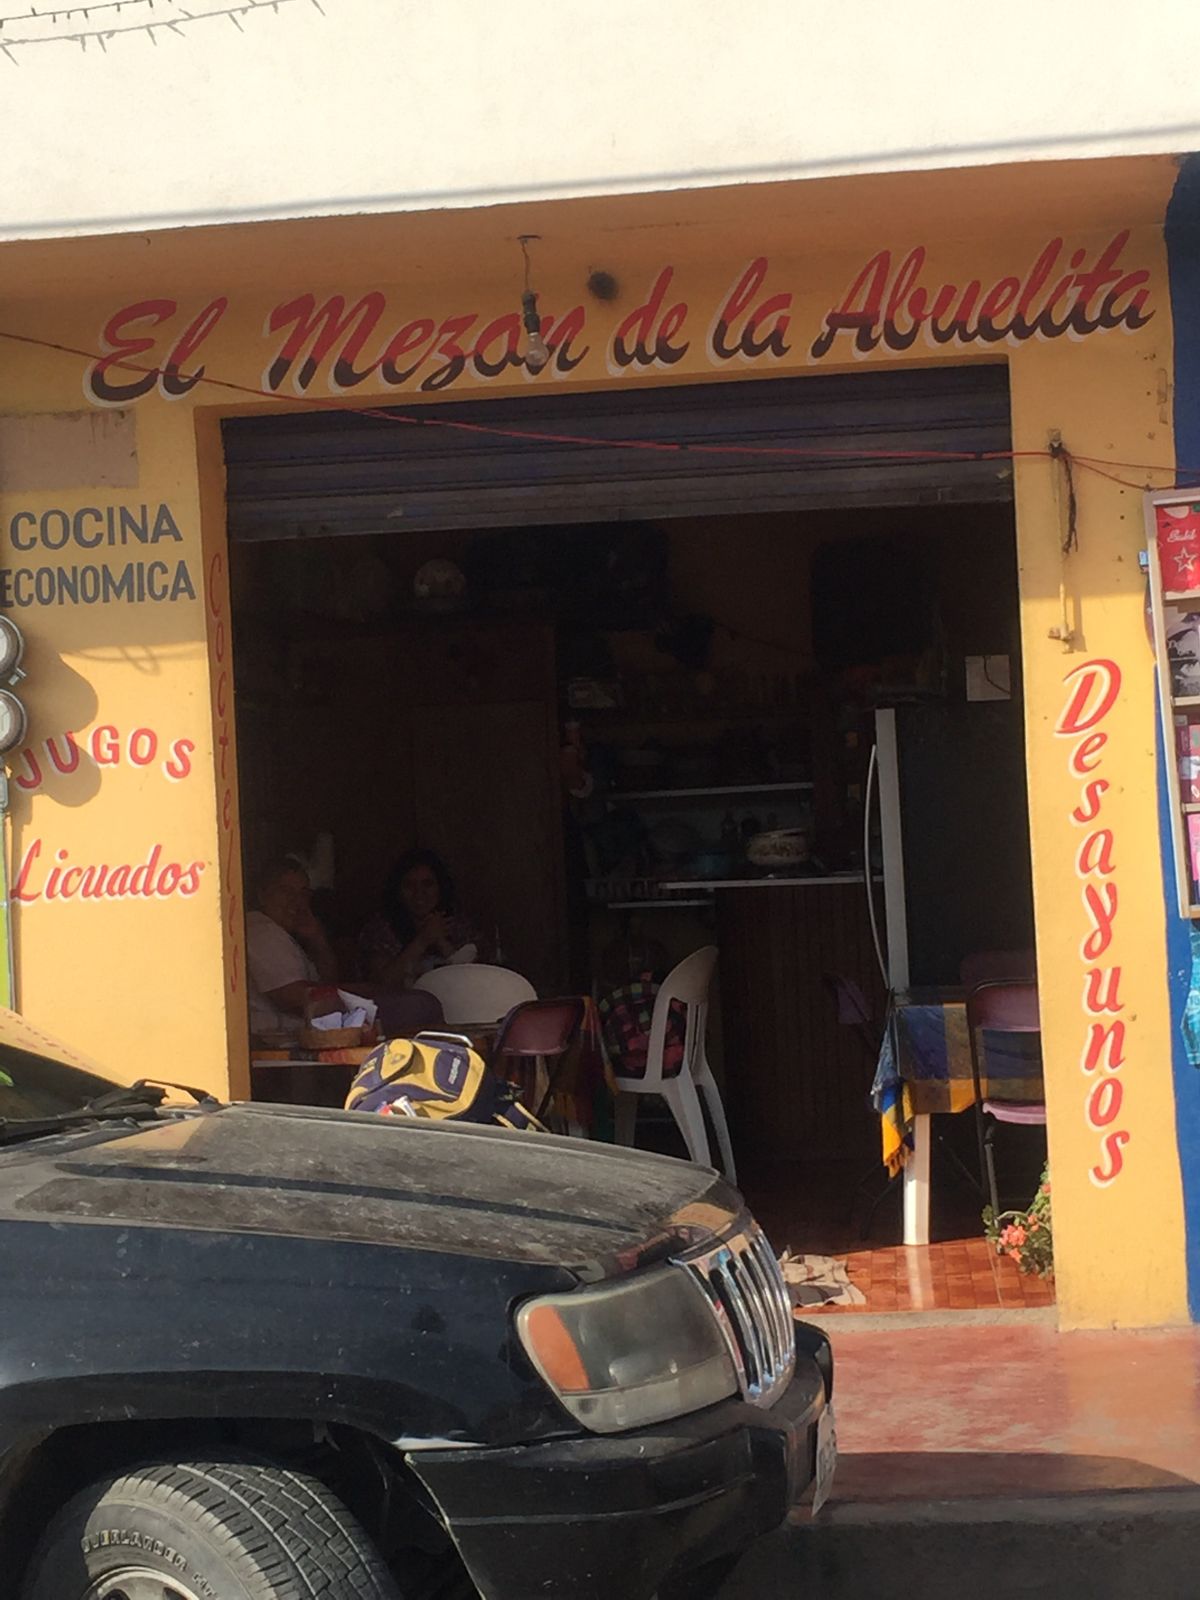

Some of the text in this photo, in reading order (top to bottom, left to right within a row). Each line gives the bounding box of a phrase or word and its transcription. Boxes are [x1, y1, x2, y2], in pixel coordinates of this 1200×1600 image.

[85, 297, 228, 406] El
[607, 266, 690, 375] de
[707, 257, 793, 365] la
[808, 229, 1156, 364] Abuelita
[10, 503, 183, 551] COCINA
[0, 560, 196, 608] ECONOMICA
[16, 725, 195, 789] JUGOS
[9, 838, 206, 905] Licuados
[1054, 658, 1130, 1188] Desayunos
